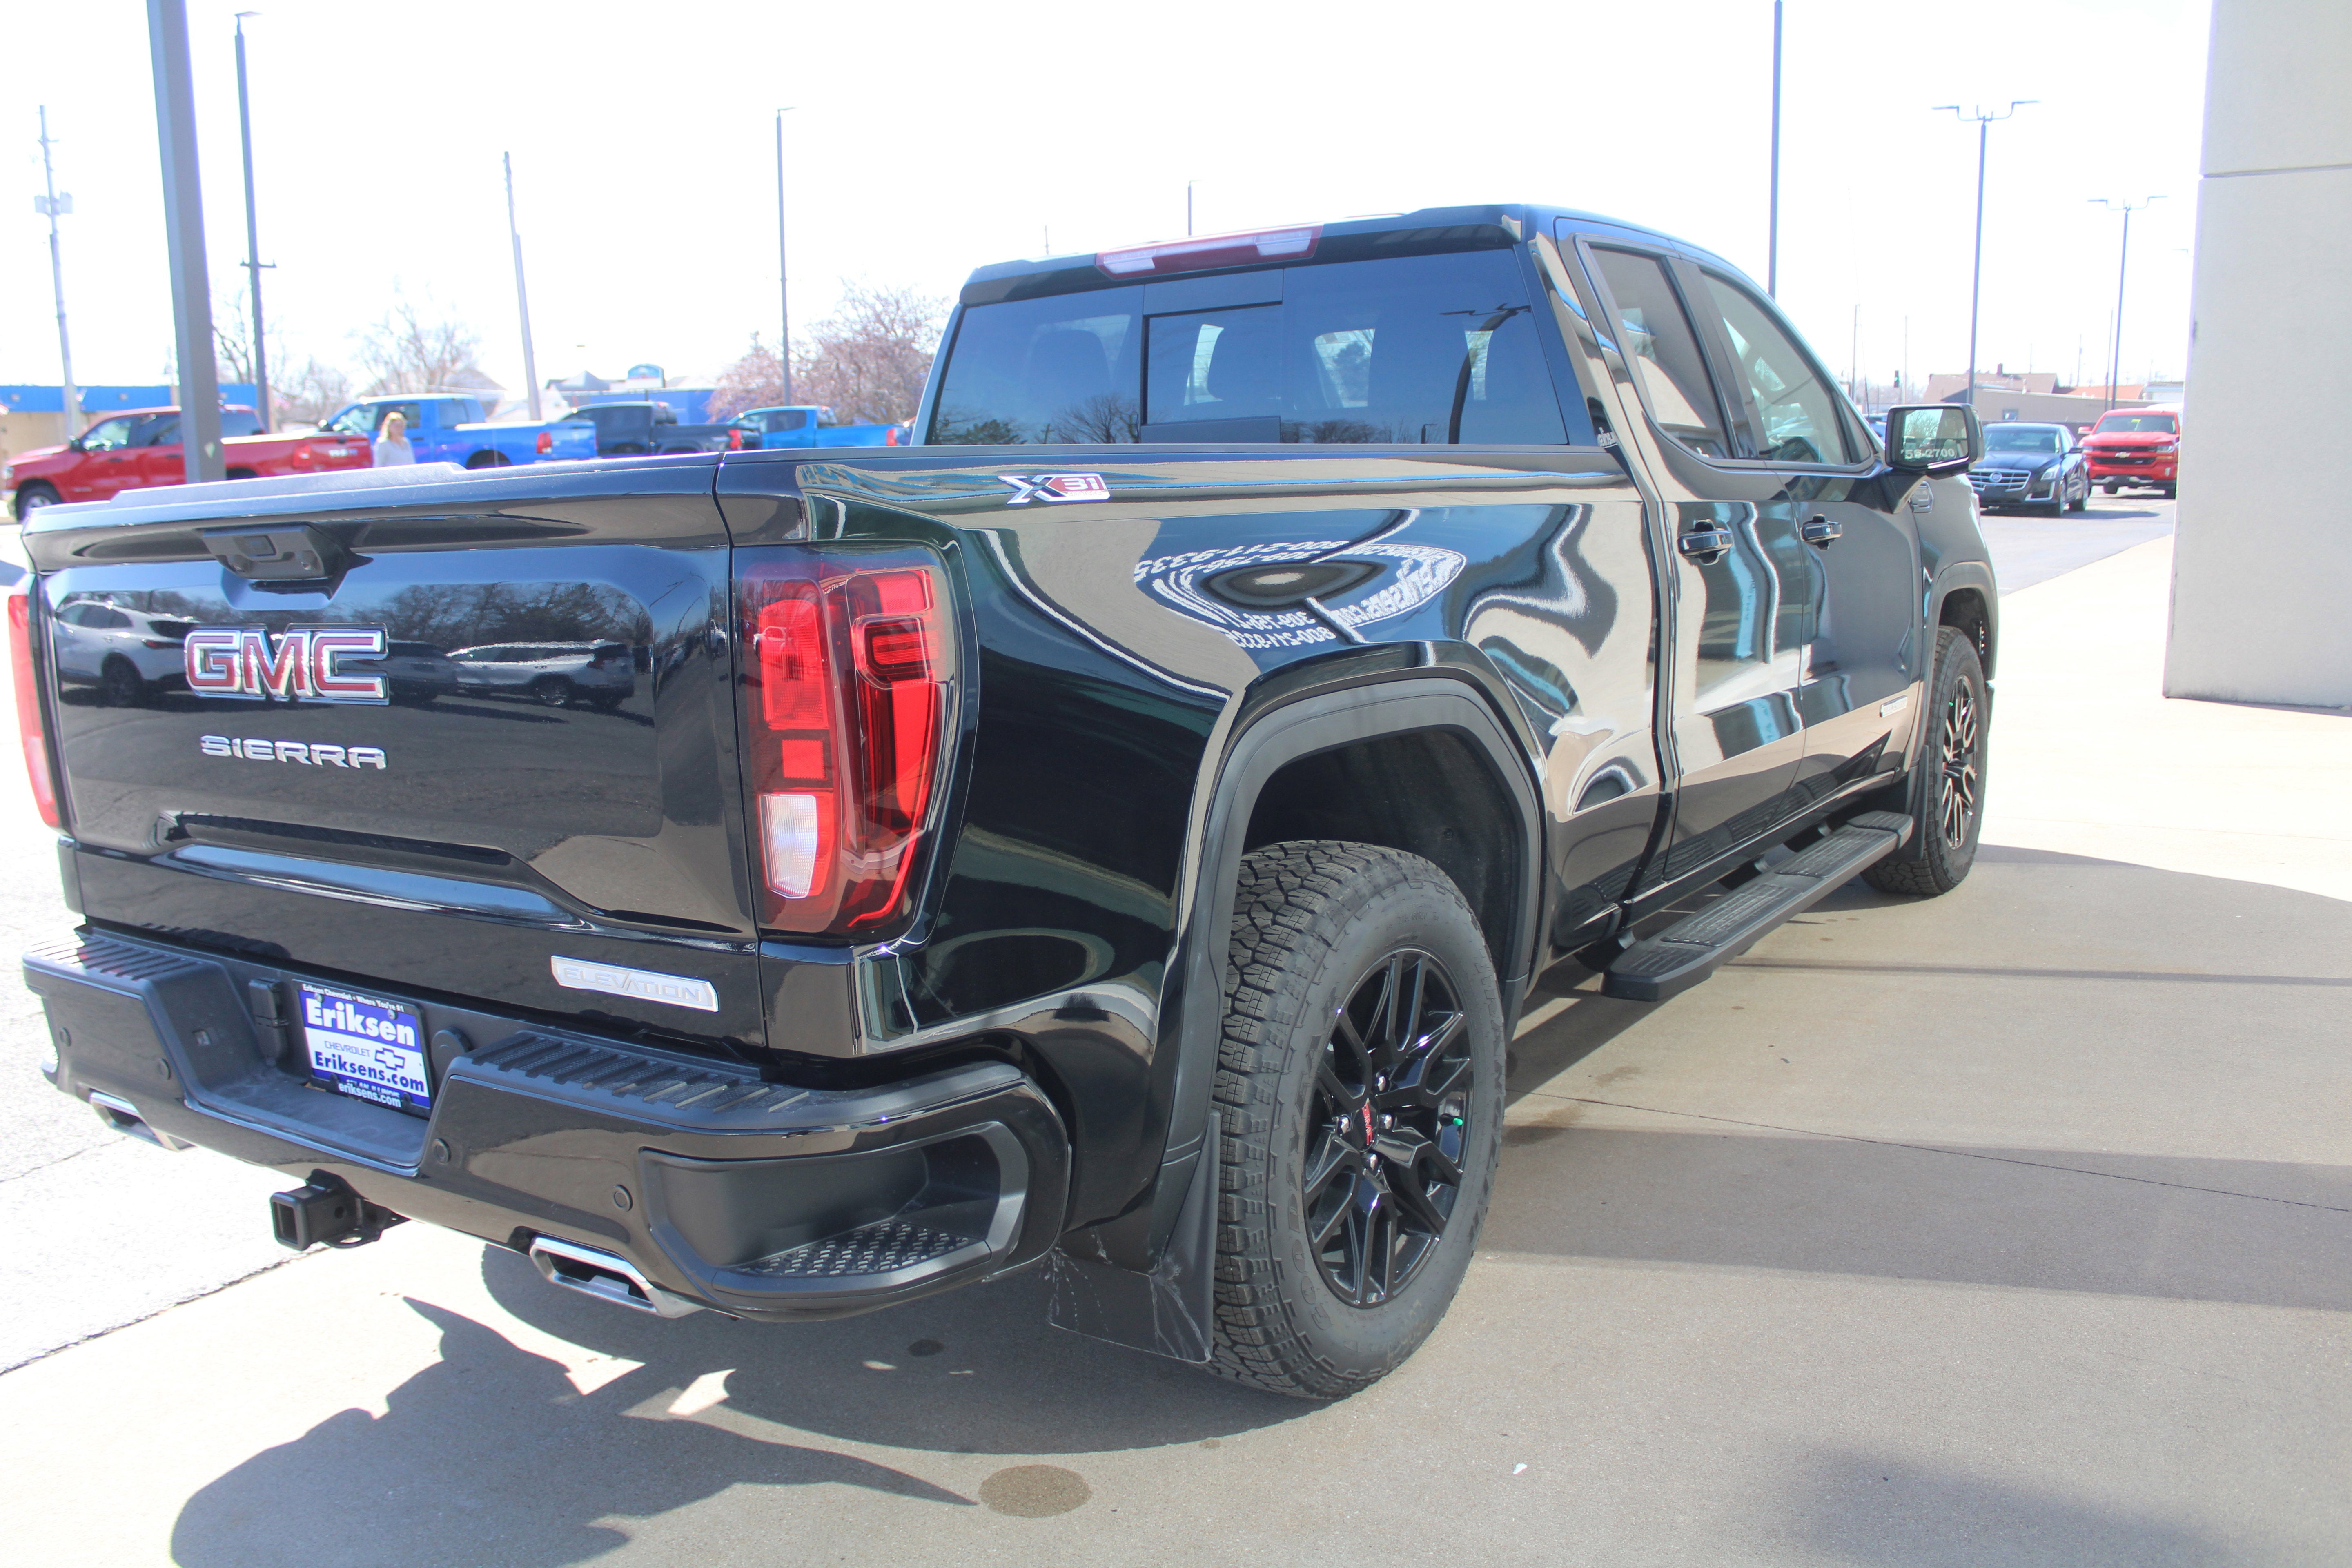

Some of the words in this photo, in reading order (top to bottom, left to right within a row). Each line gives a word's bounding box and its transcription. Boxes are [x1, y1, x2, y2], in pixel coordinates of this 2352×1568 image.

[184, 623, 389, 705] GMC
[200, 735, 388, 770] SIERRA
[302, 983, 325, 995] Eriksen
[324, 988, 353, 1001] Chevrolet
[356, 995, 376, 1006] Where
[564, 967, 702, 1002] ELEVATION
[306, 998, 416, 1047] Eriksen
[324, 1040, 370, 1057] CHEVROLET
[314, 1051, 424, 1092] Eriksens.com
[338, 1082, 402, 1108] eriksens.com
[1362, 1103, 1373, 1145] GMC
